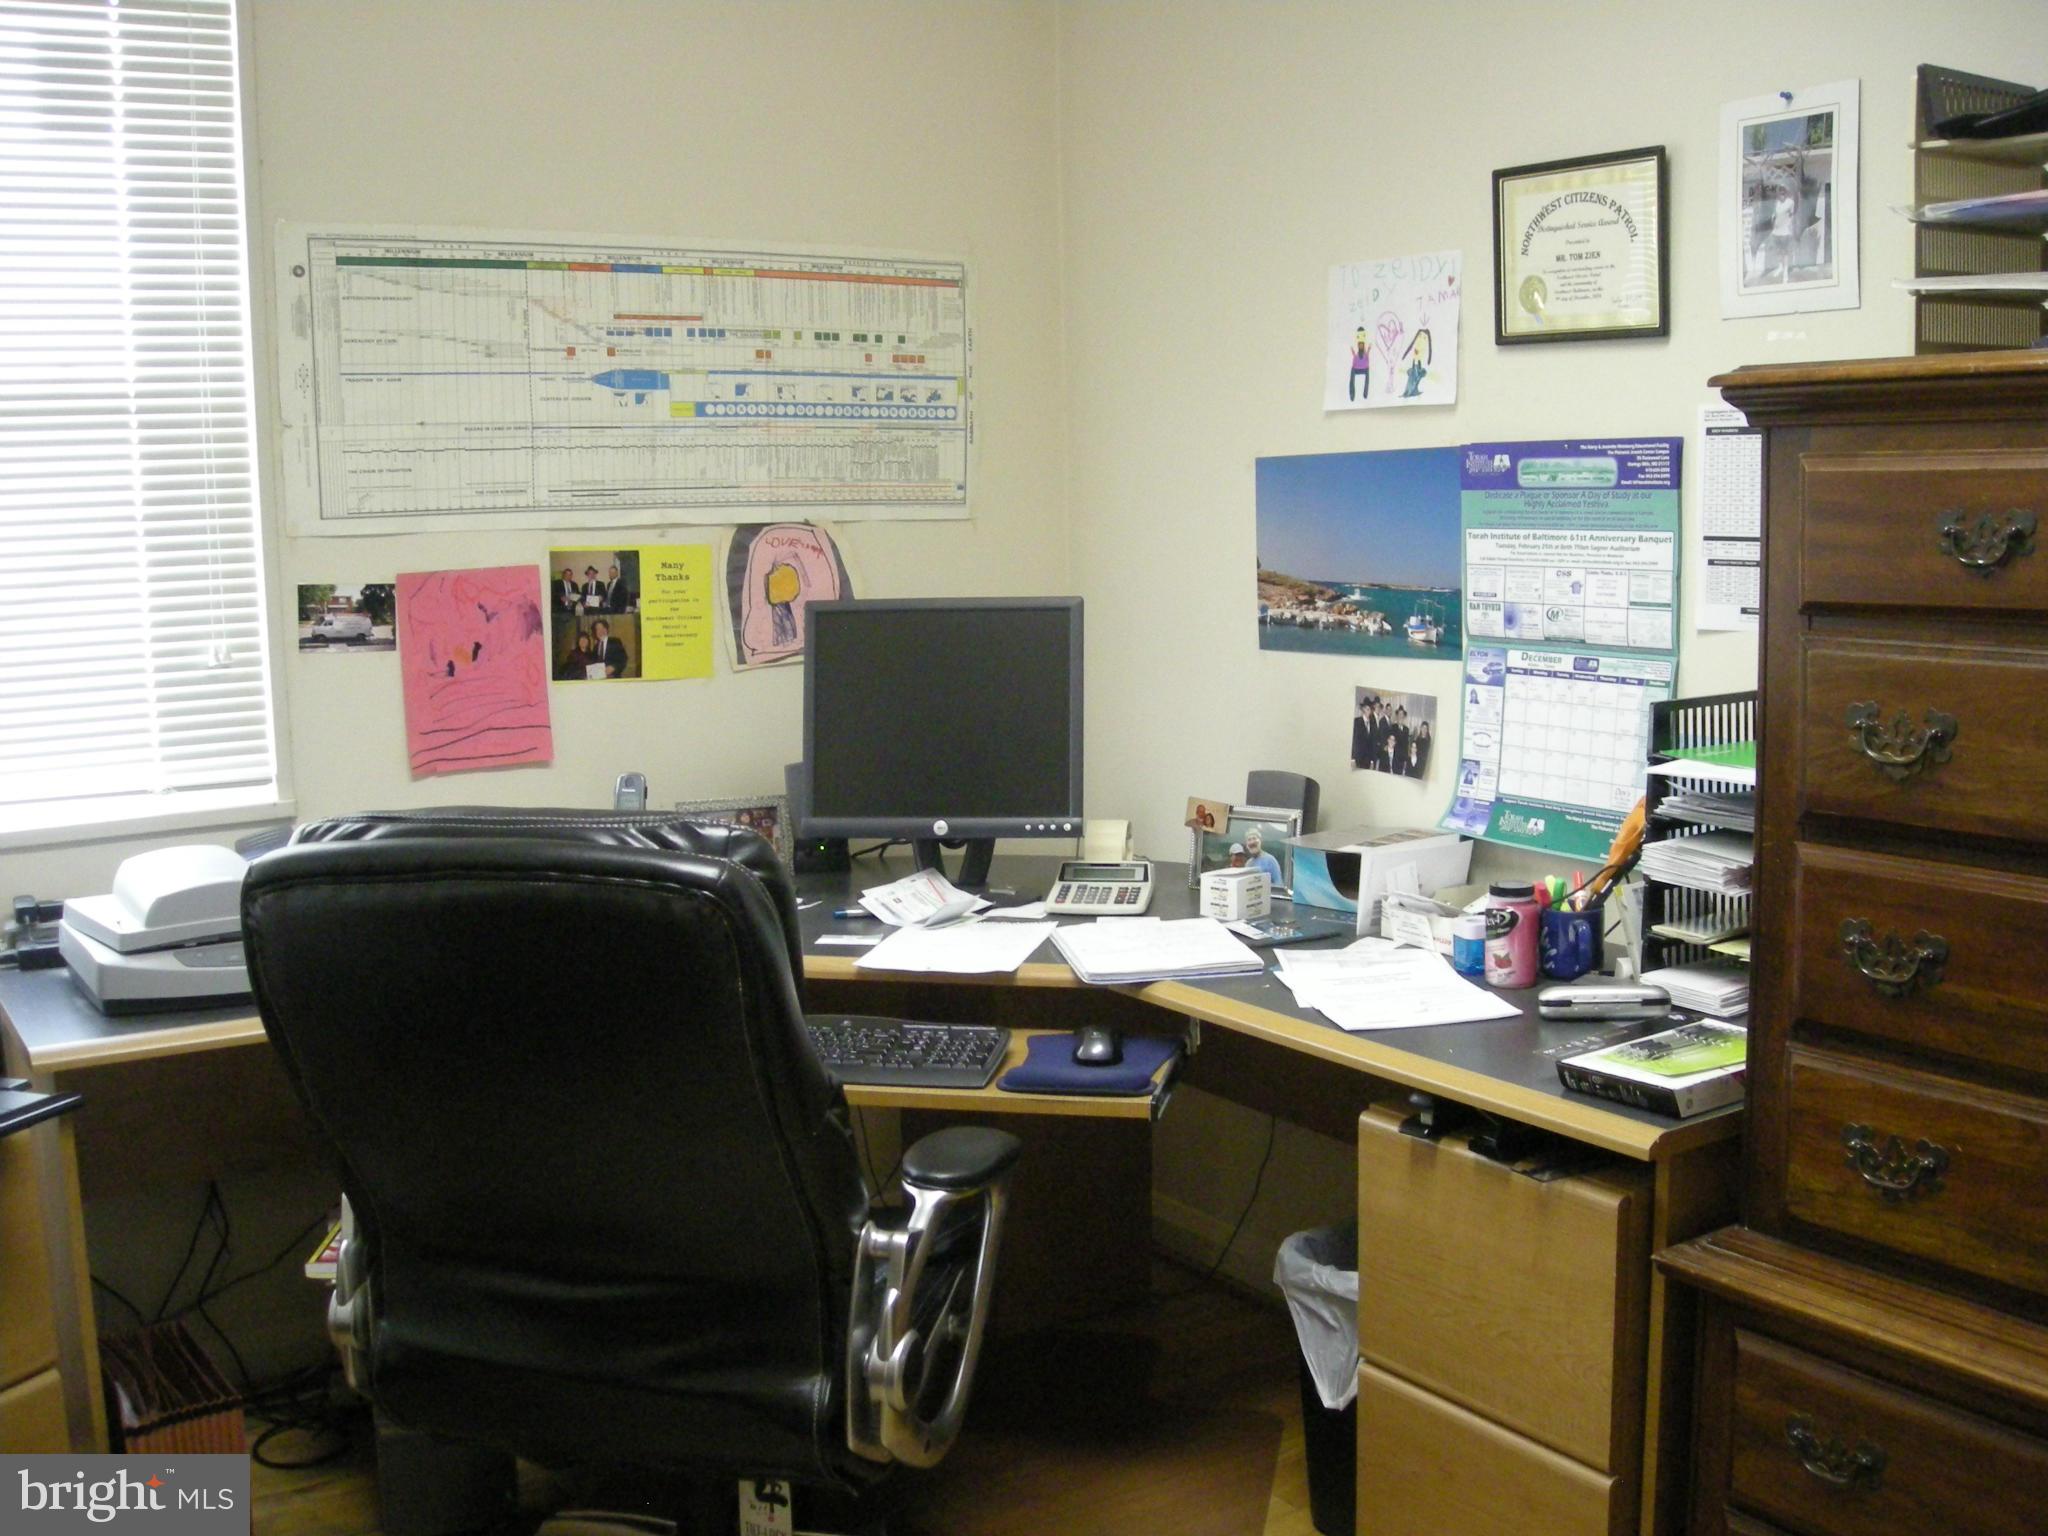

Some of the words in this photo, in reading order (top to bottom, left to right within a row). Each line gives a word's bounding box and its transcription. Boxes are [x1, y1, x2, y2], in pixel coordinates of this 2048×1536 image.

[1521, 196, 1563, 257] NORTHWEST
[1564, 191, 1609, 207] CITIZENS
[1608, 199, 1639, 243] PATROL
[1569, 252, 1583, 260] TOM
[1552, 491, 1579, 502] Sponsor
[1587, 492, 1602, 502] Day
[1611, 492, 1632, 502] Study
[1468, 532, 1489, 540] Torah
[1491, 532, 1521, 540] Institute
[1532, 533, 1567, 541] Baltimore
[1589, 534, 1636, 545] Anniversary
[1638, 535, 1673, 544] Banquet
[661, 562, 685, 570] Many
[655, 573, 690, 581] Thanks
